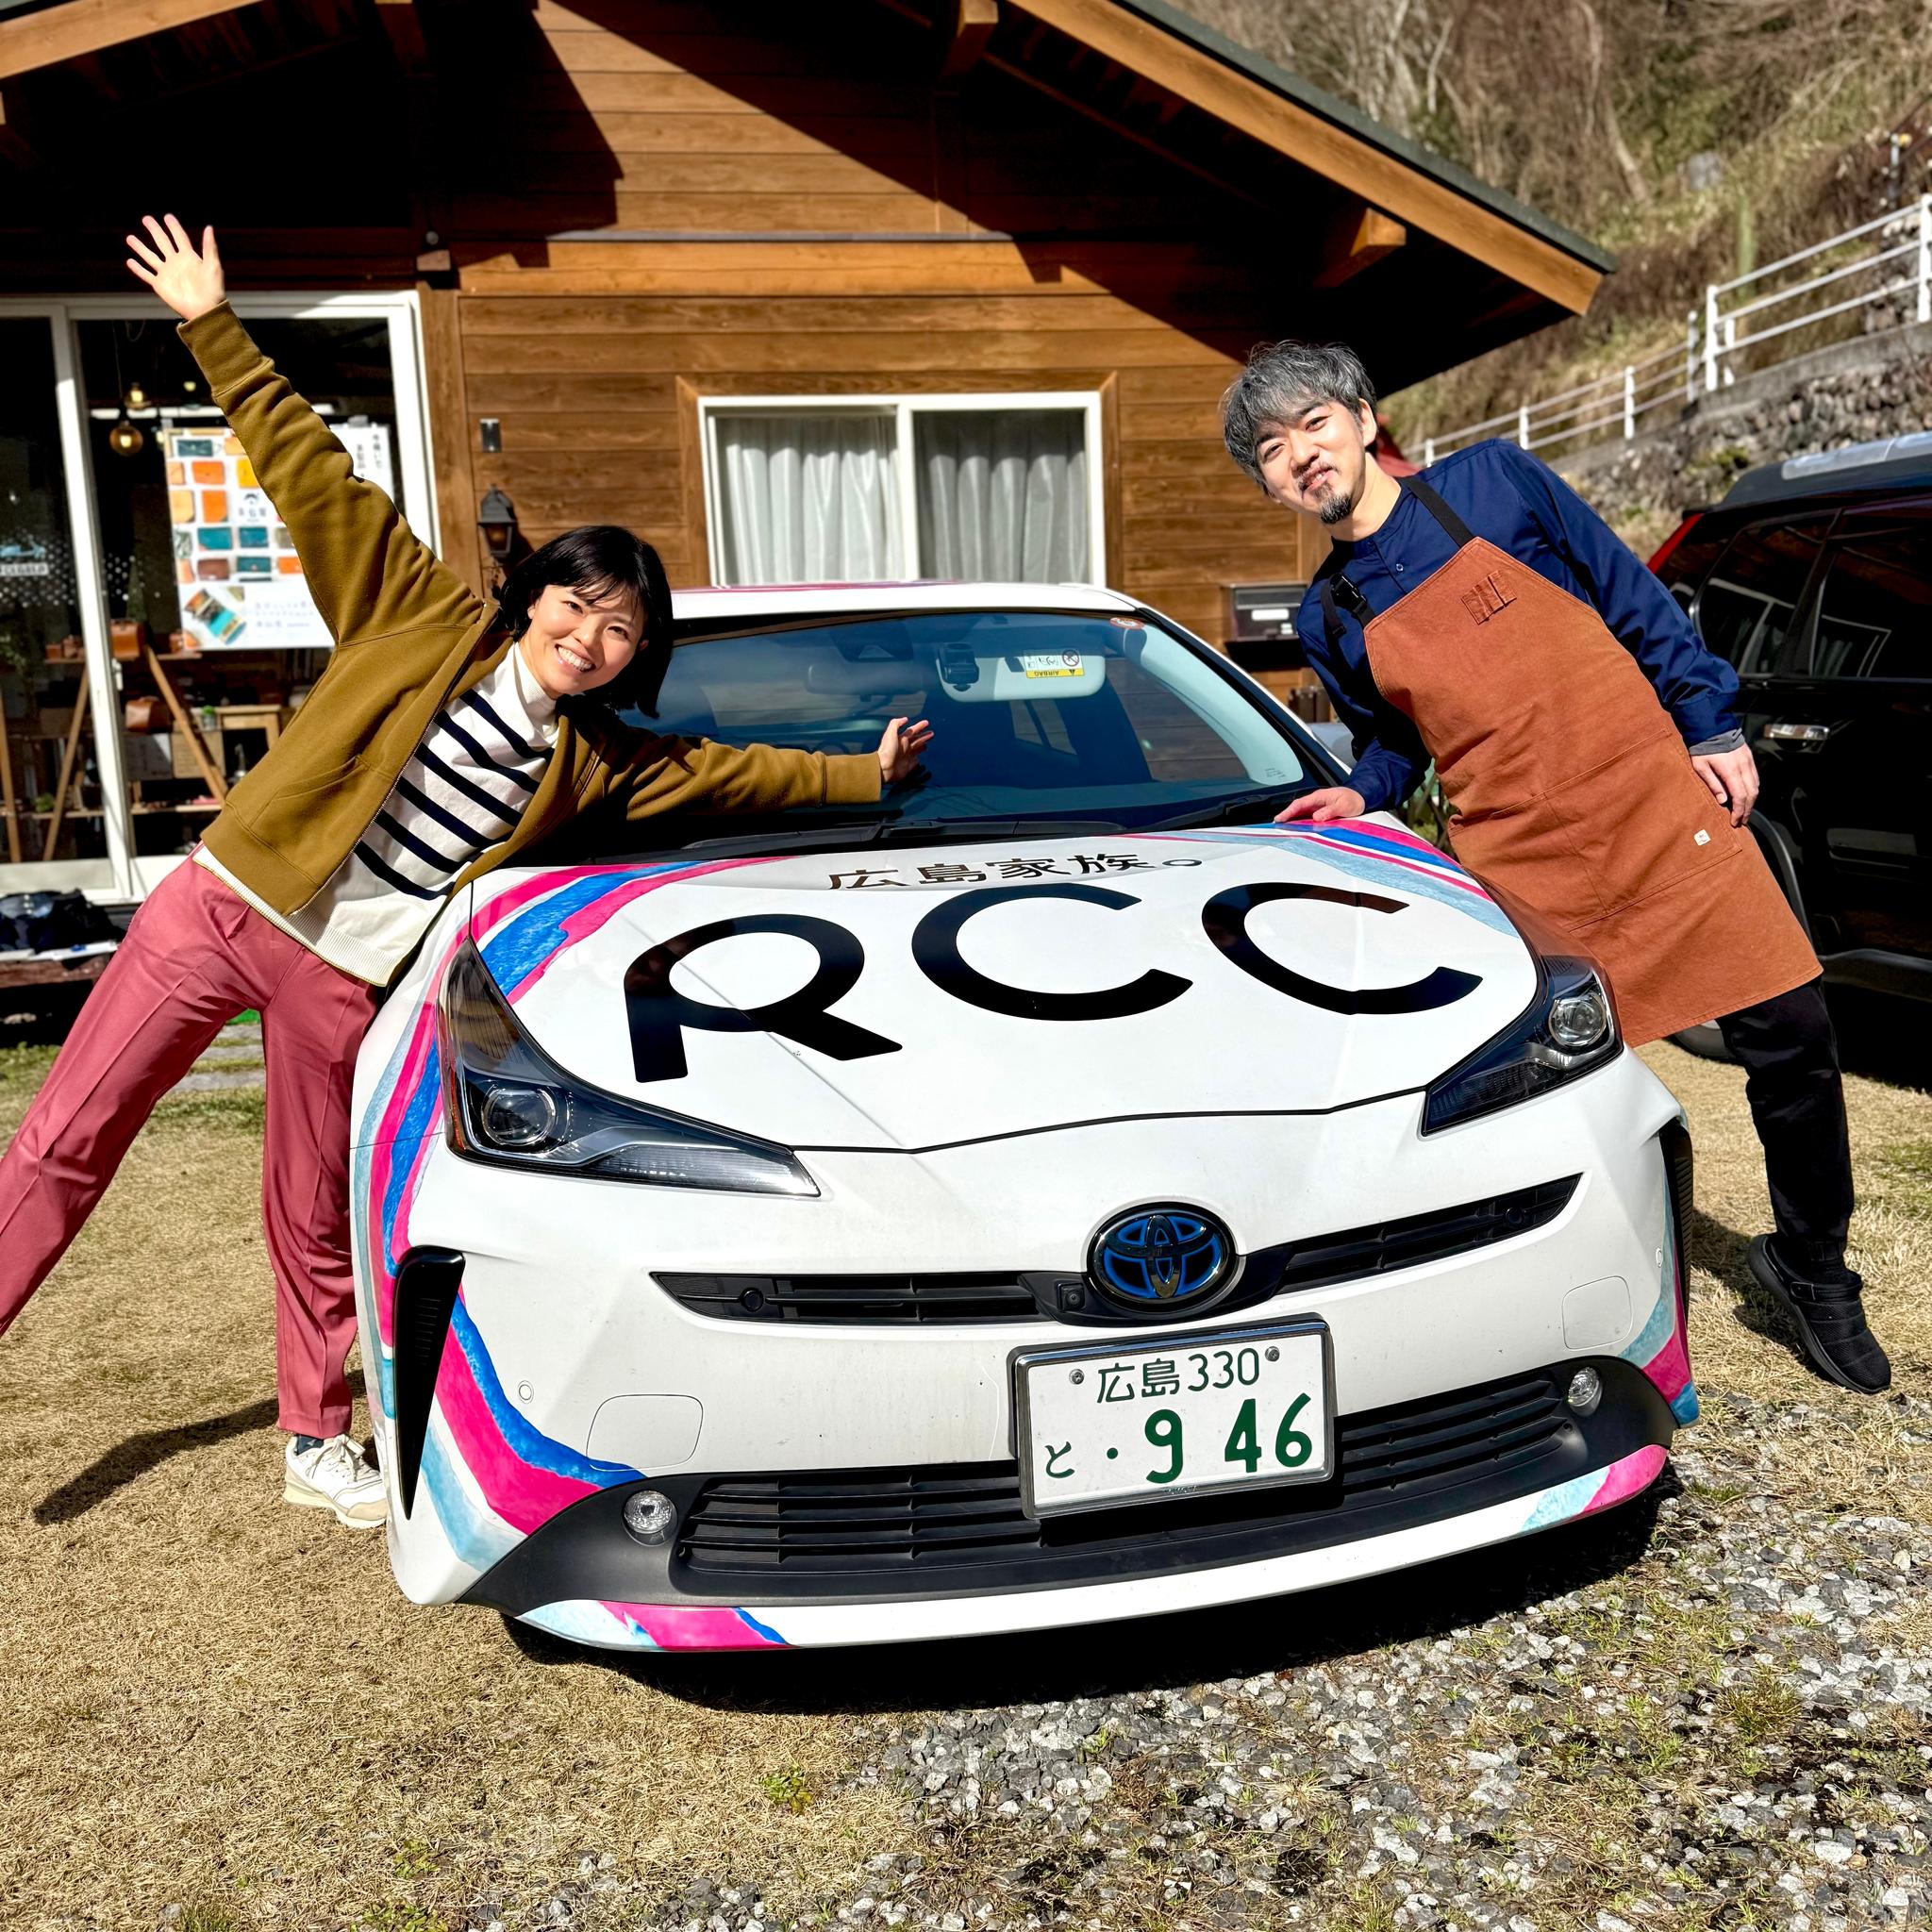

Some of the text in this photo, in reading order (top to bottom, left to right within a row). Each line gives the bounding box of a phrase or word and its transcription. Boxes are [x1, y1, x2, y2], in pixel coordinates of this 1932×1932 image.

[828, 853, 1203, 891] 広島家族。
[623, 882, 1483, 1083] RCC
